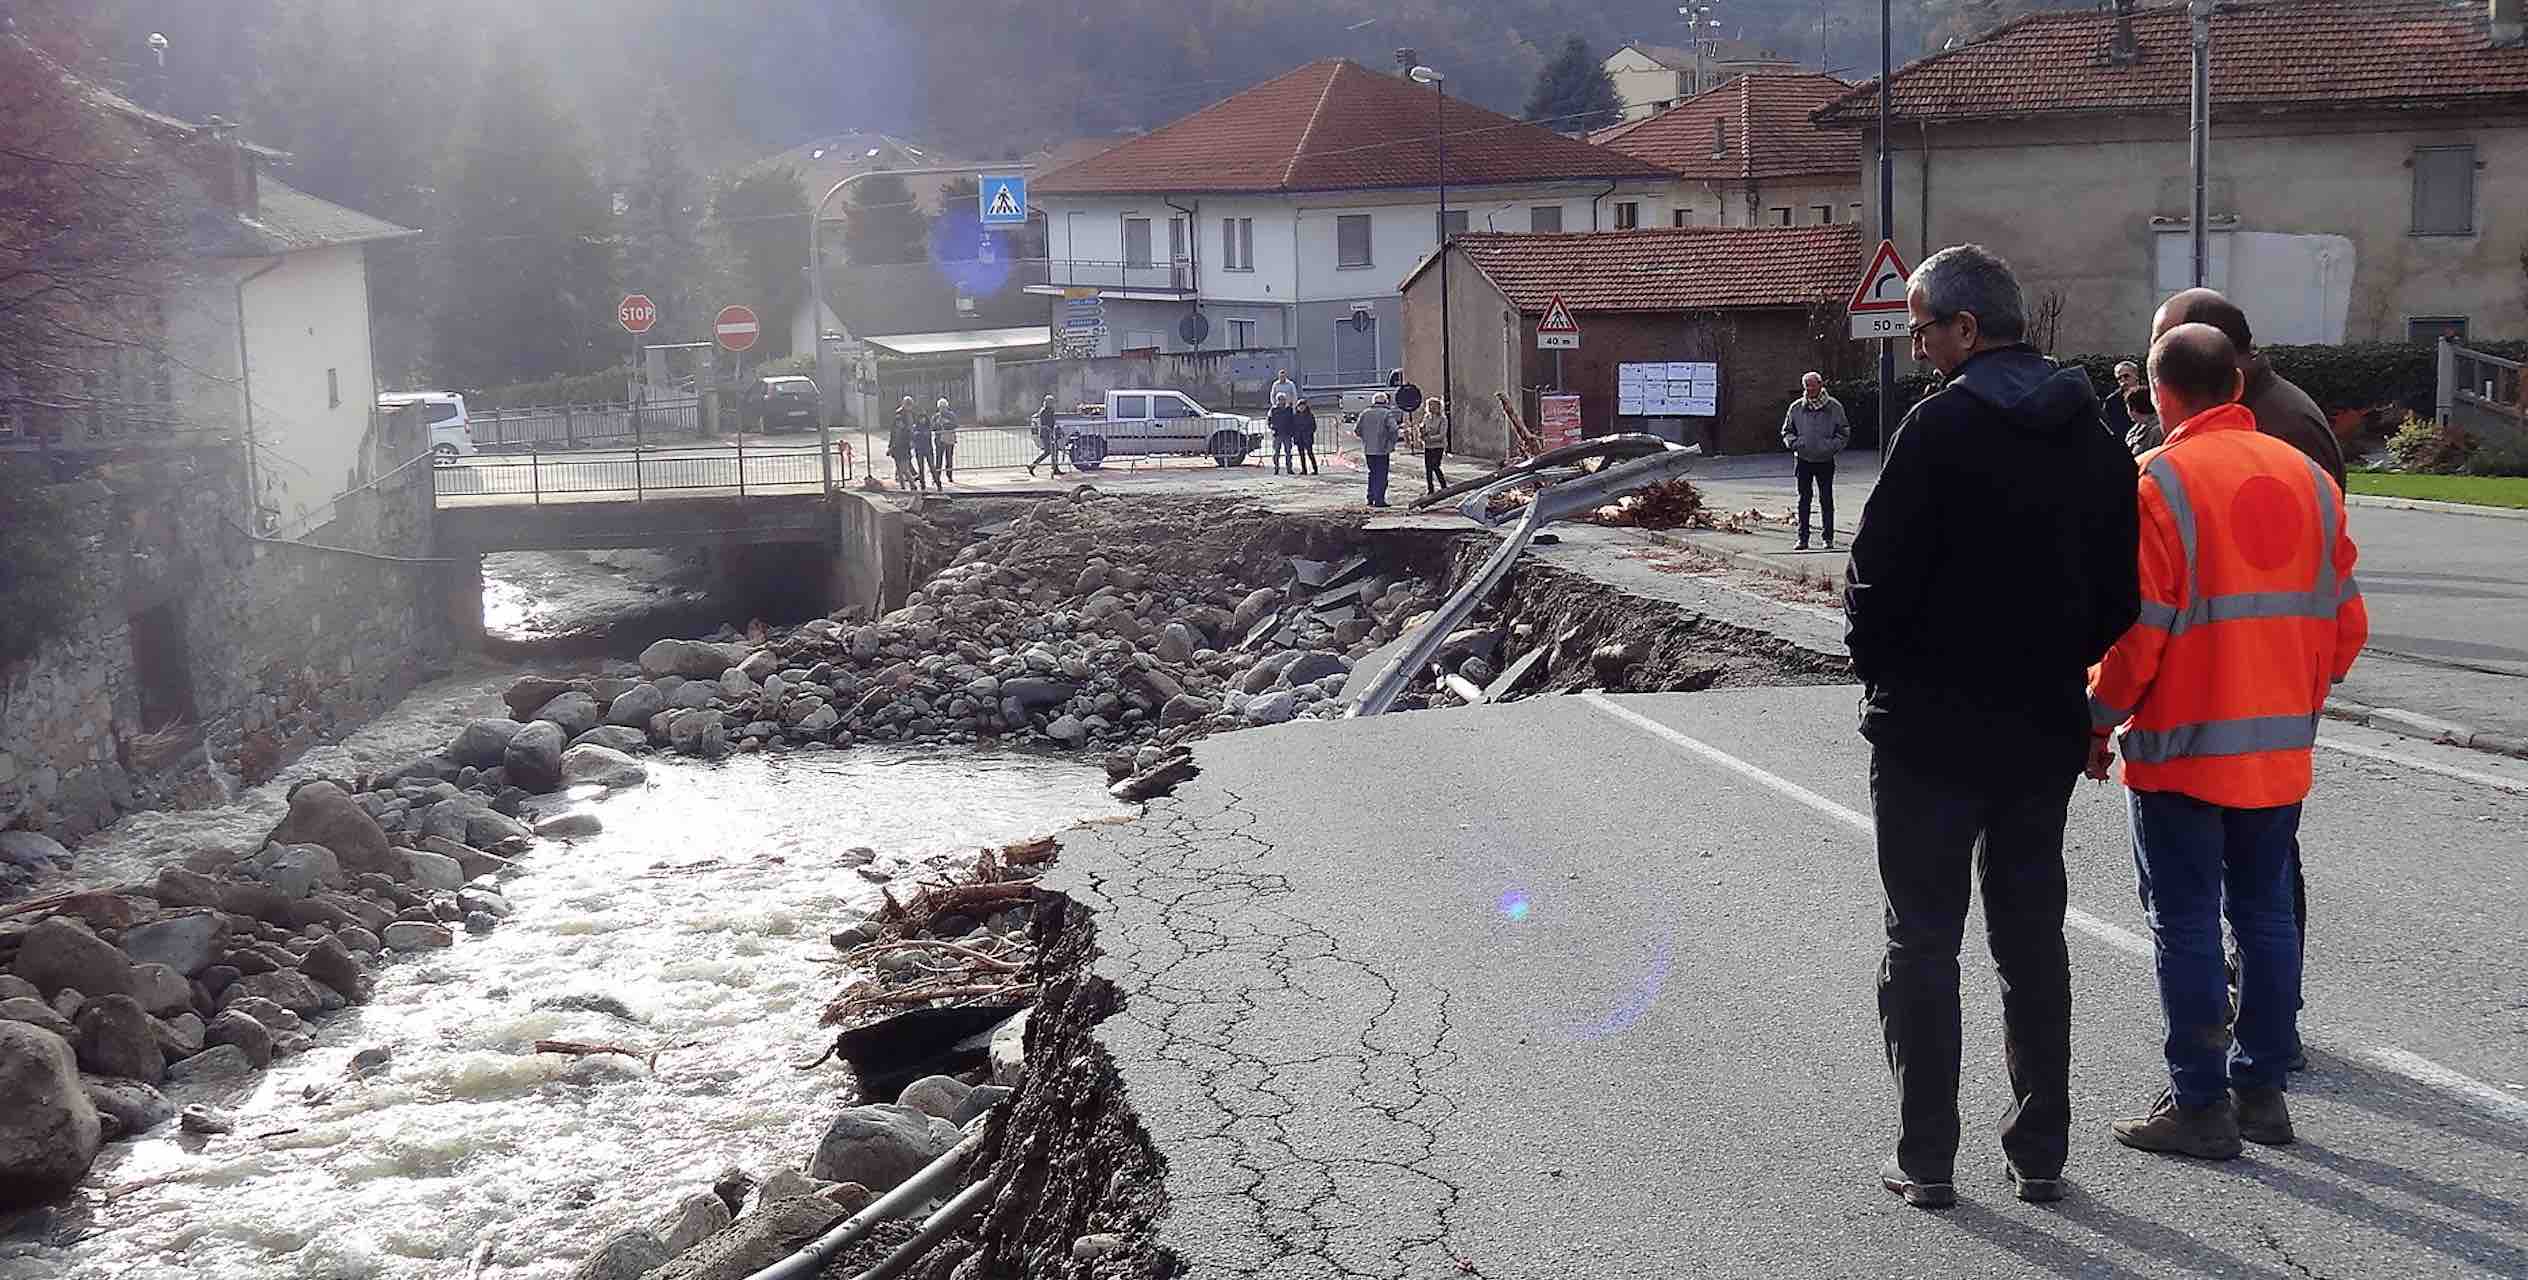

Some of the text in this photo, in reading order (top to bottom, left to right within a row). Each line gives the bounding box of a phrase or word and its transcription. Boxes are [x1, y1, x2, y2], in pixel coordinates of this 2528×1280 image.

[622, 307, 652, 321] STOP
[1873, 320, 1905, 331] 50 m
[1546, 336, 1559, 345] 40
